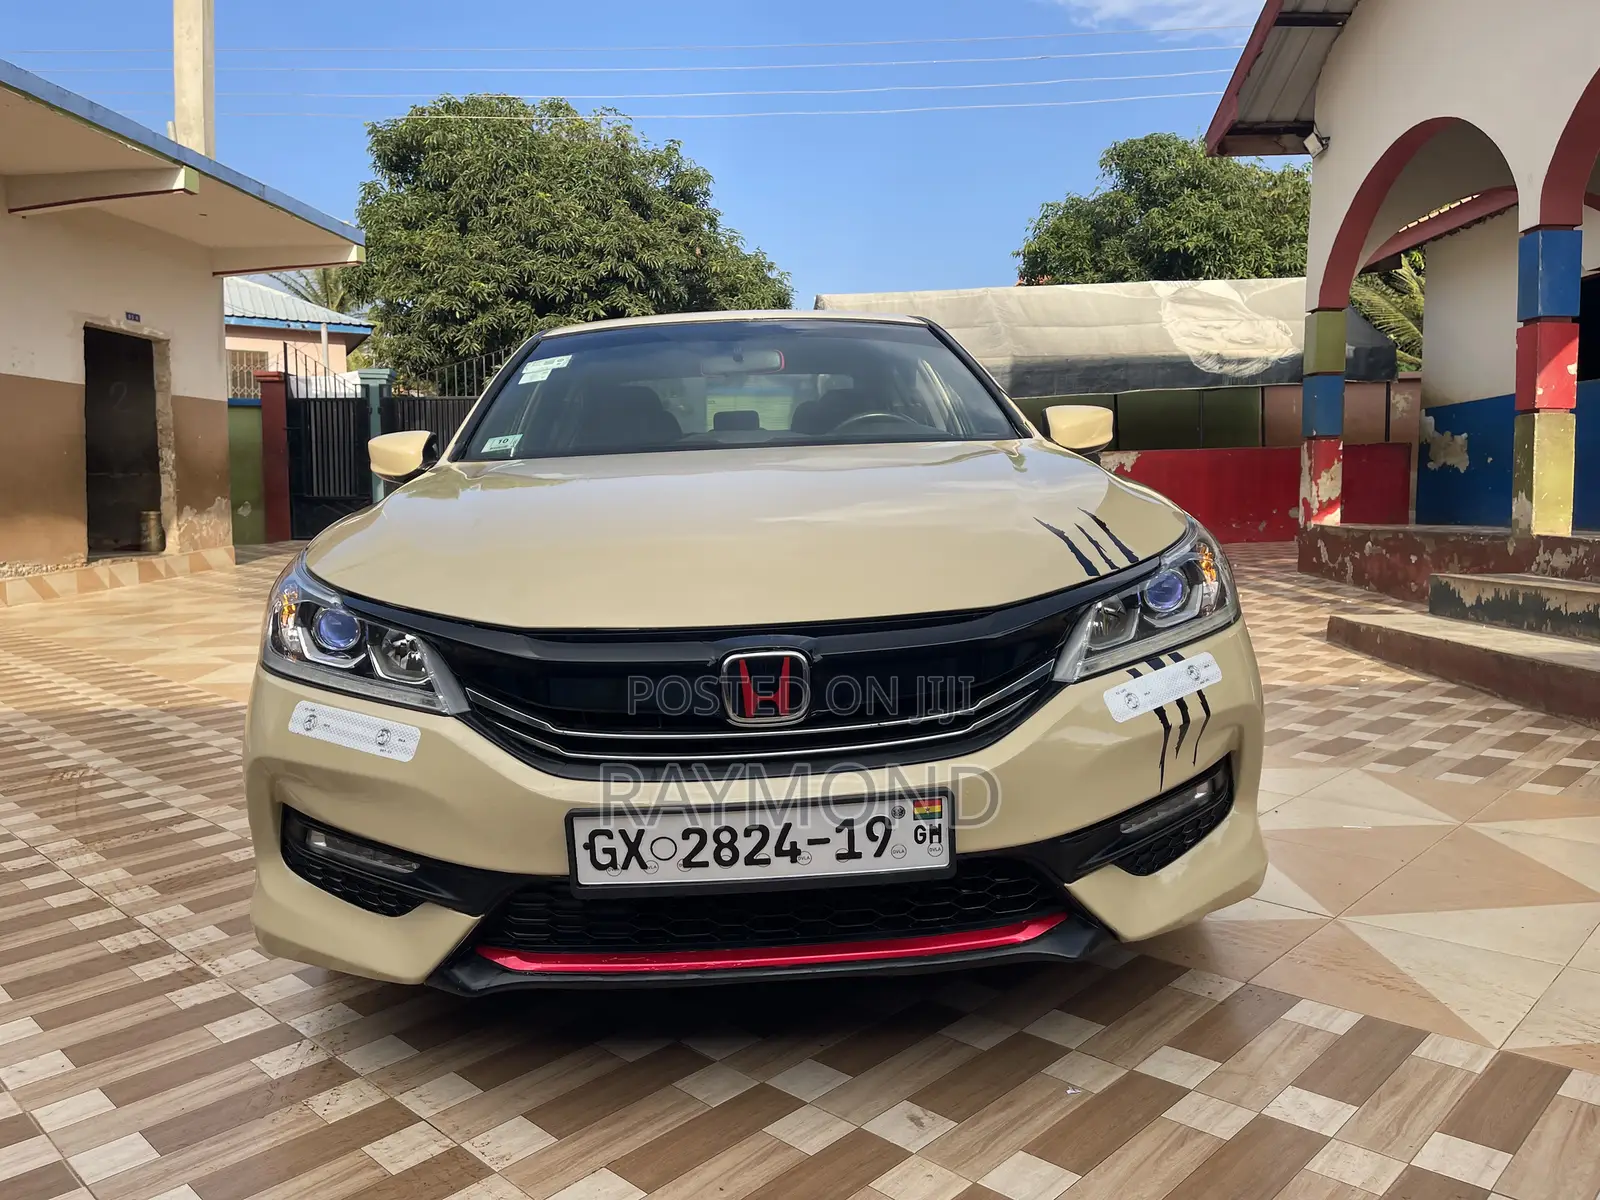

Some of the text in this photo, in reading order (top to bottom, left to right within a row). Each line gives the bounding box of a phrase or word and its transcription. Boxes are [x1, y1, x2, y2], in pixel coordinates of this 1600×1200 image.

[739, 656, 790, 718] H
[588, 815, 892, 871] GX 2824-19
[914, 823, 942, 845] GH
